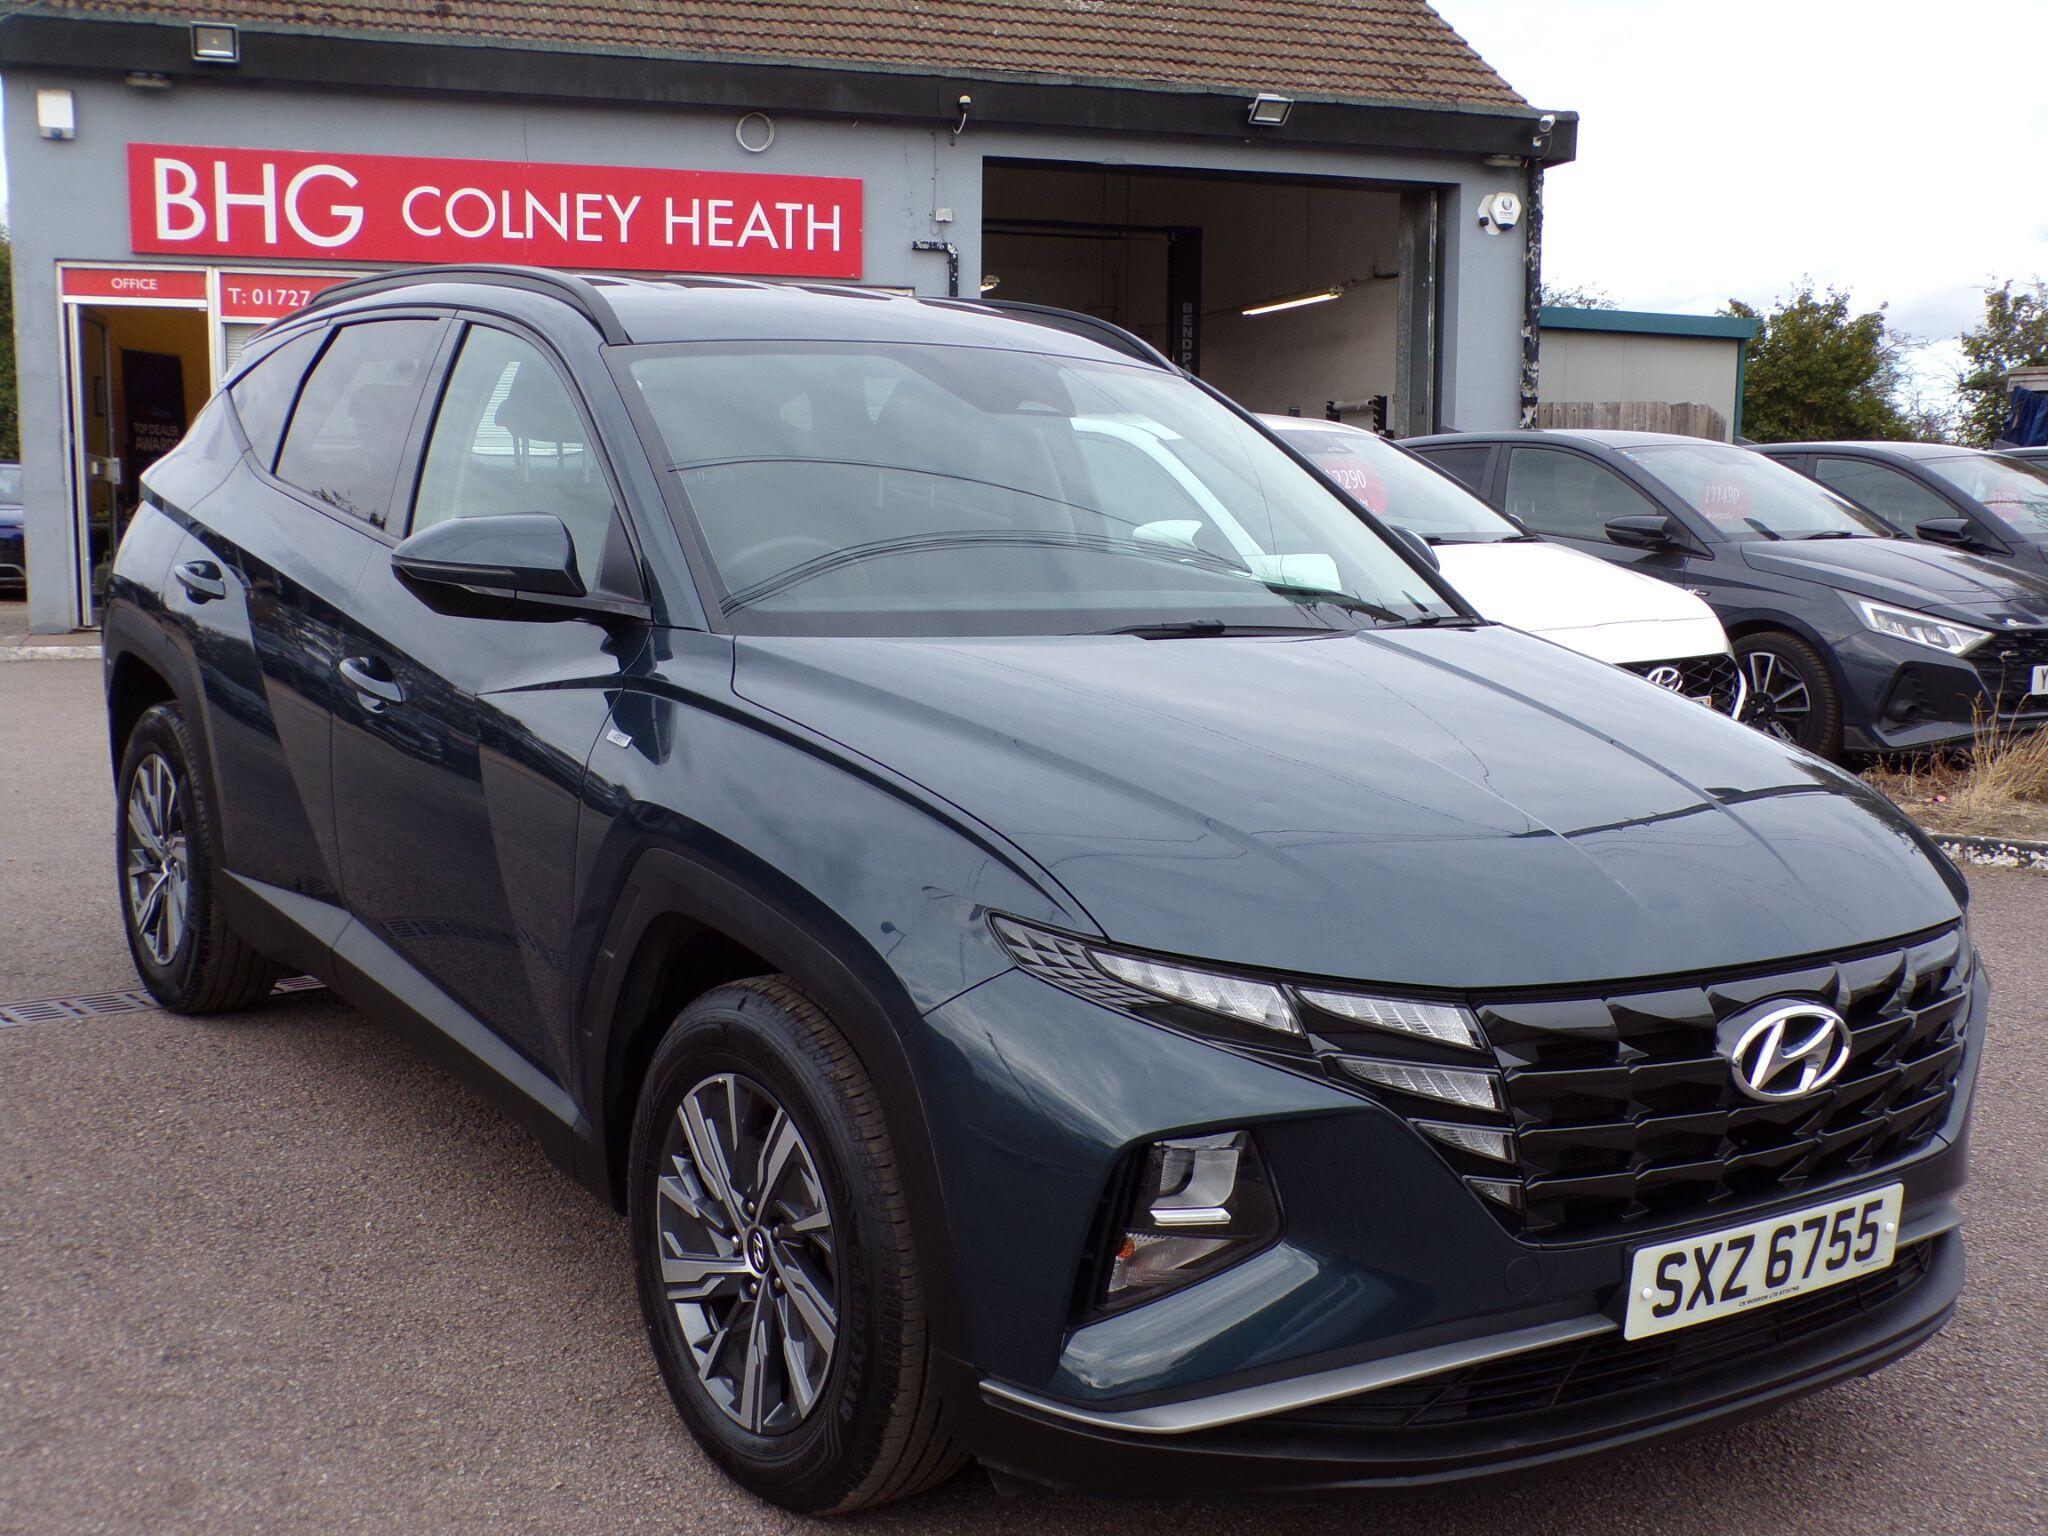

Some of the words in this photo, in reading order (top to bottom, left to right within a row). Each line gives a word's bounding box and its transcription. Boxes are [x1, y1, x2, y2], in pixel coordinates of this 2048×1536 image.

[154, 157, 364, 248] BHG
[401, 185, 640, 243] COLNEY
[665, 197, 841, 251] HEATH
[110, 277, 158, 291] OFFICE
[228, 287, 247, 305] T:
[252, 288, 311, 307] 01727
[1651, 1234, 1756, 1318] SXZ
[1765, 1199, 1884, 1289] 6755
